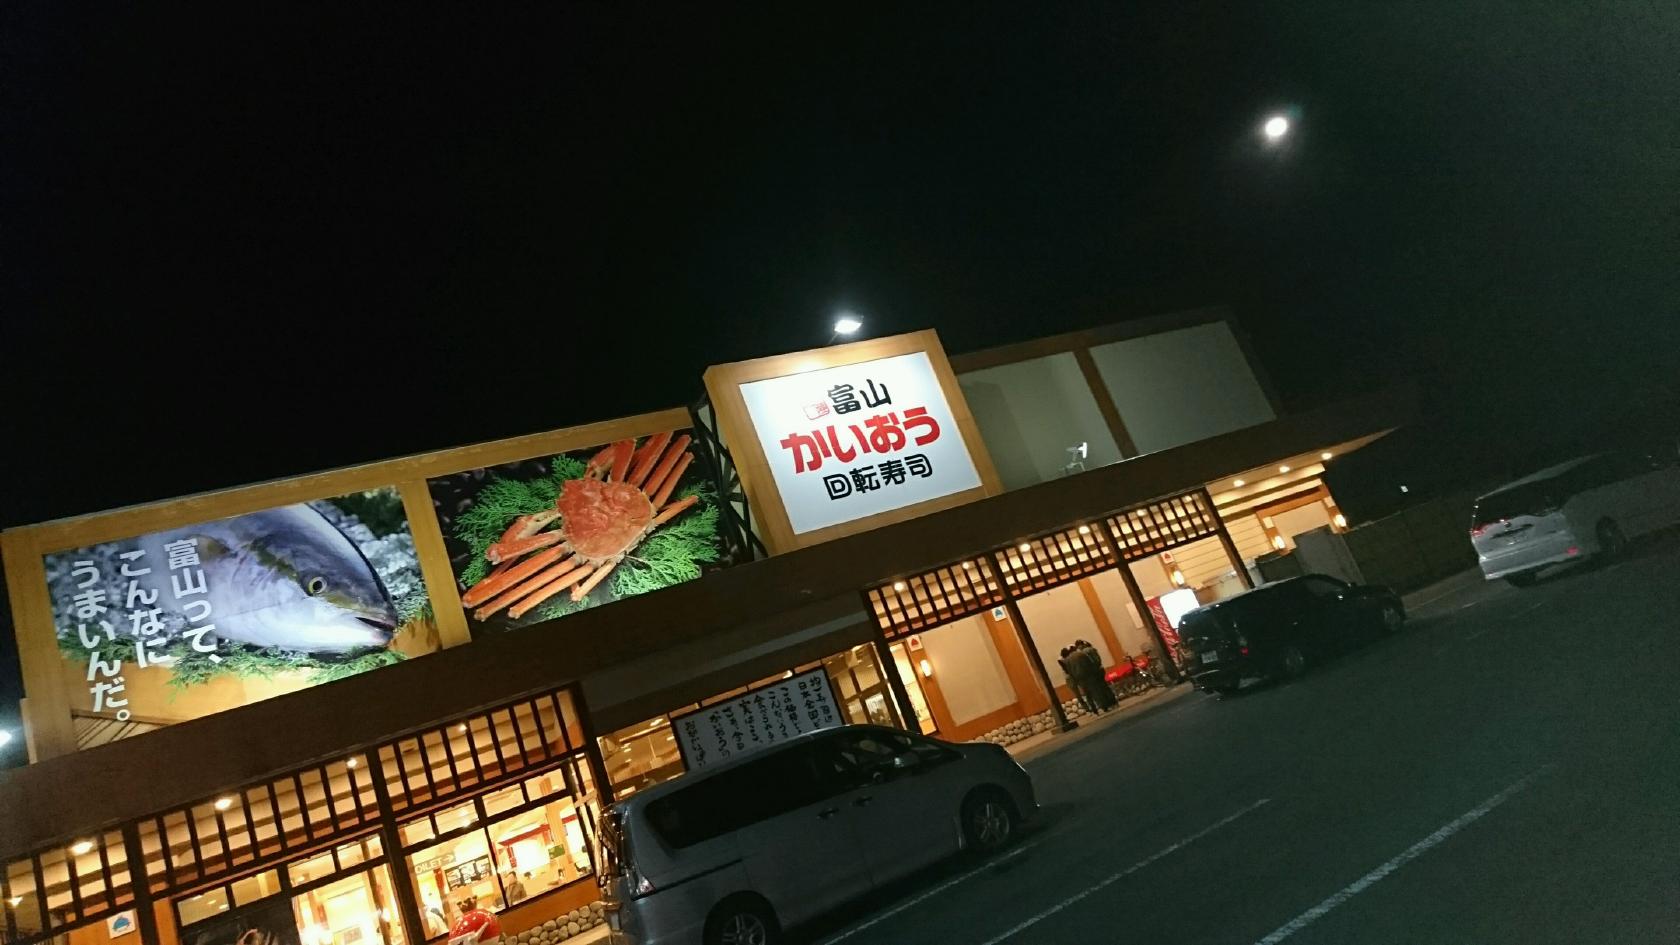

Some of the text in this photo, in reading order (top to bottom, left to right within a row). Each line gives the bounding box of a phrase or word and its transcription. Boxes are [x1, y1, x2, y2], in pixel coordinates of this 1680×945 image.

[780, 407, 940, 474] かいおう
[828, 379, 891, 414] 富山
[823, 454, 933, 500] 回転寿司
[72, 560, 131, 721] うまいんだ。
[120, 550, 170, 668] こんなに
[164, 538, 222, 663] 富山って、
